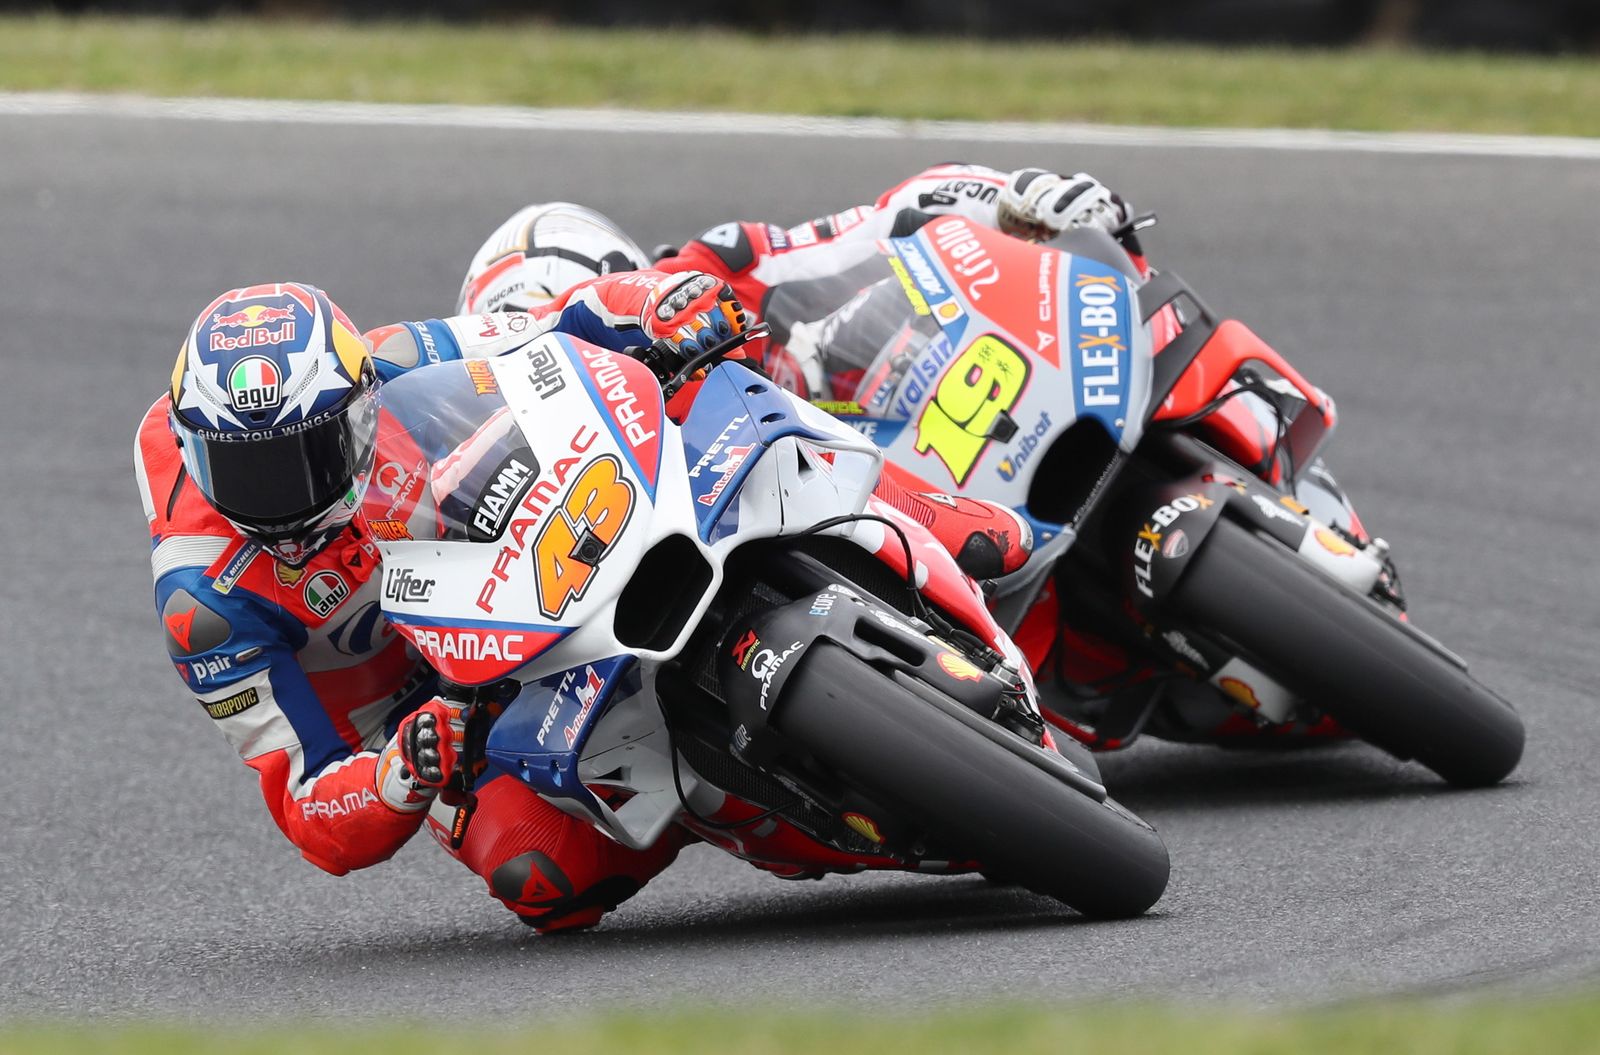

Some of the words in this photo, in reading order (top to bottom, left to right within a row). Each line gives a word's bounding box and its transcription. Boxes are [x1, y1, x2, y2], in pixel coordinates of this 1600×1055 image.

[487, 282, 525, 308] DUCATI
[1039, 251, 1053, 322] CUPRA
[210, 329, 251, 351] Red
[254, 322, 295, 346] Bull
[414, 321, 441, 363] DAINE
[1075, 273, 1127, 406] FLEX-BOX
[237, 386, 275, 409] agv
[528, 344, 566, 400] Lifter
[583, 347, 656, 448] PRAMAC
[895, 339, 953, 417] valsir
[197, 428, 233, 443] GIVES
[241, 429, 273, 442] YOU
[281, 411, 332, 436] WINGS
[915, 331, 1033, 489] 19
[688, 413, 750, 478] PRETTL
[996, 410, 1052, 482] Unibat
[385, 461, 425, 520] PRAMAC
[473, 459, 530, 534] FIAMM
[697, 459, 742, 507] Articolo
[476, 425, 599, 614] PRAMAC
[531, 453, 637, 622] 43
[1134, 493, 1213, 598] FLEX-BOX
[318, 584, 345, 613] agv
[386, 568, 435, 602] Lifter
[413, 629, 524, 661] PRAMAC
[760, 641, 804, 710] PRAMAC
[537, 671, 576, 747] PRETTL
[563, 695, 595, 750] Articolo
[301, 787, 378, 821] PRAMA
